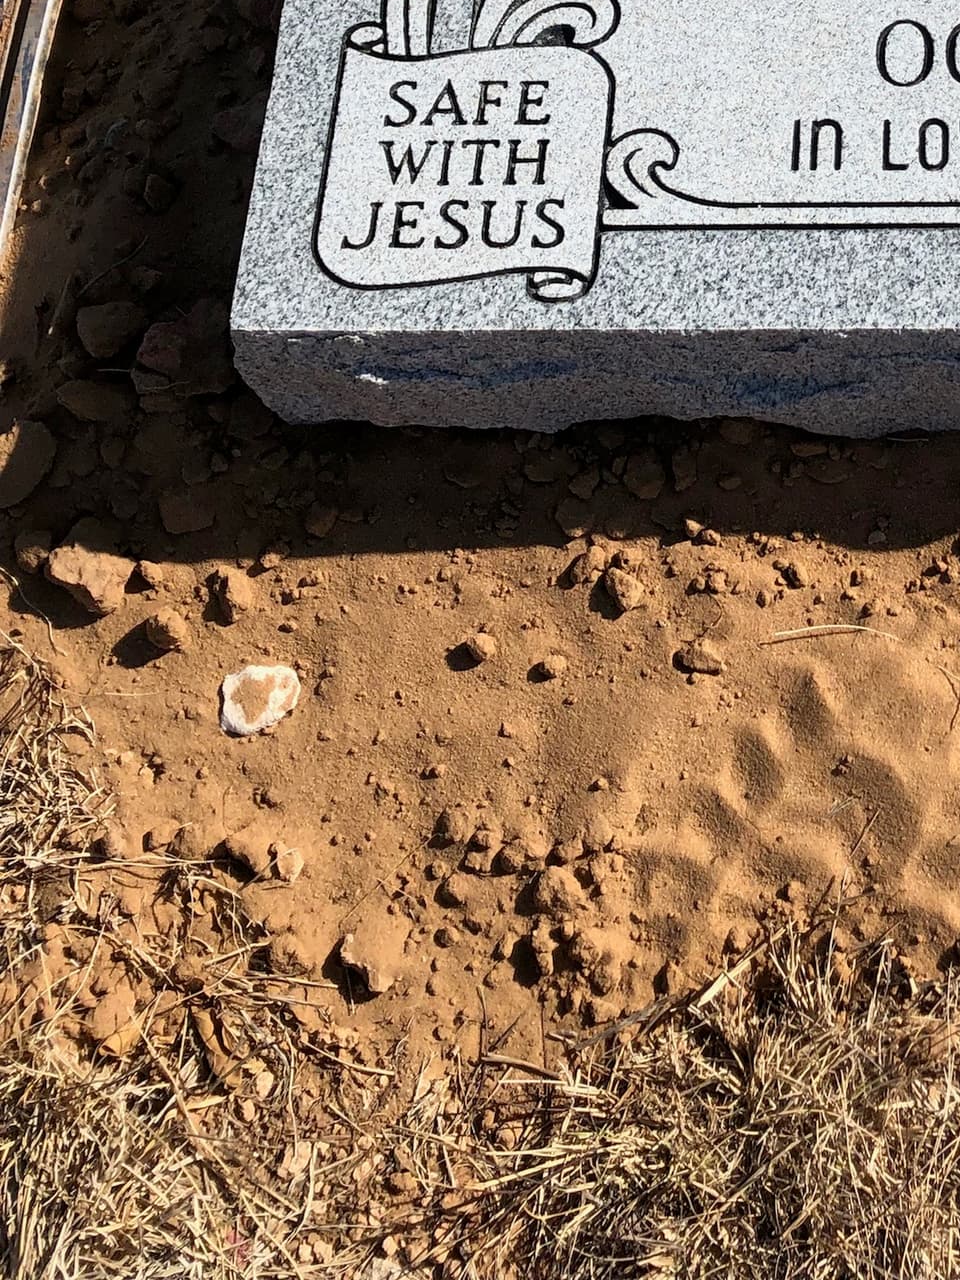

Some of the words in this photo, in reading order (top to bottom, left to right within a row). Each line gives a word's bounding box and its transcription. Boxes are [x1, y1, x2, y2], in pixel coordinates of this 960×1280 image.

[384, 79, 551, 128] SAFE
[379, 139, 550, 186] WITH
[341, 198, 565, 250] JESUS
